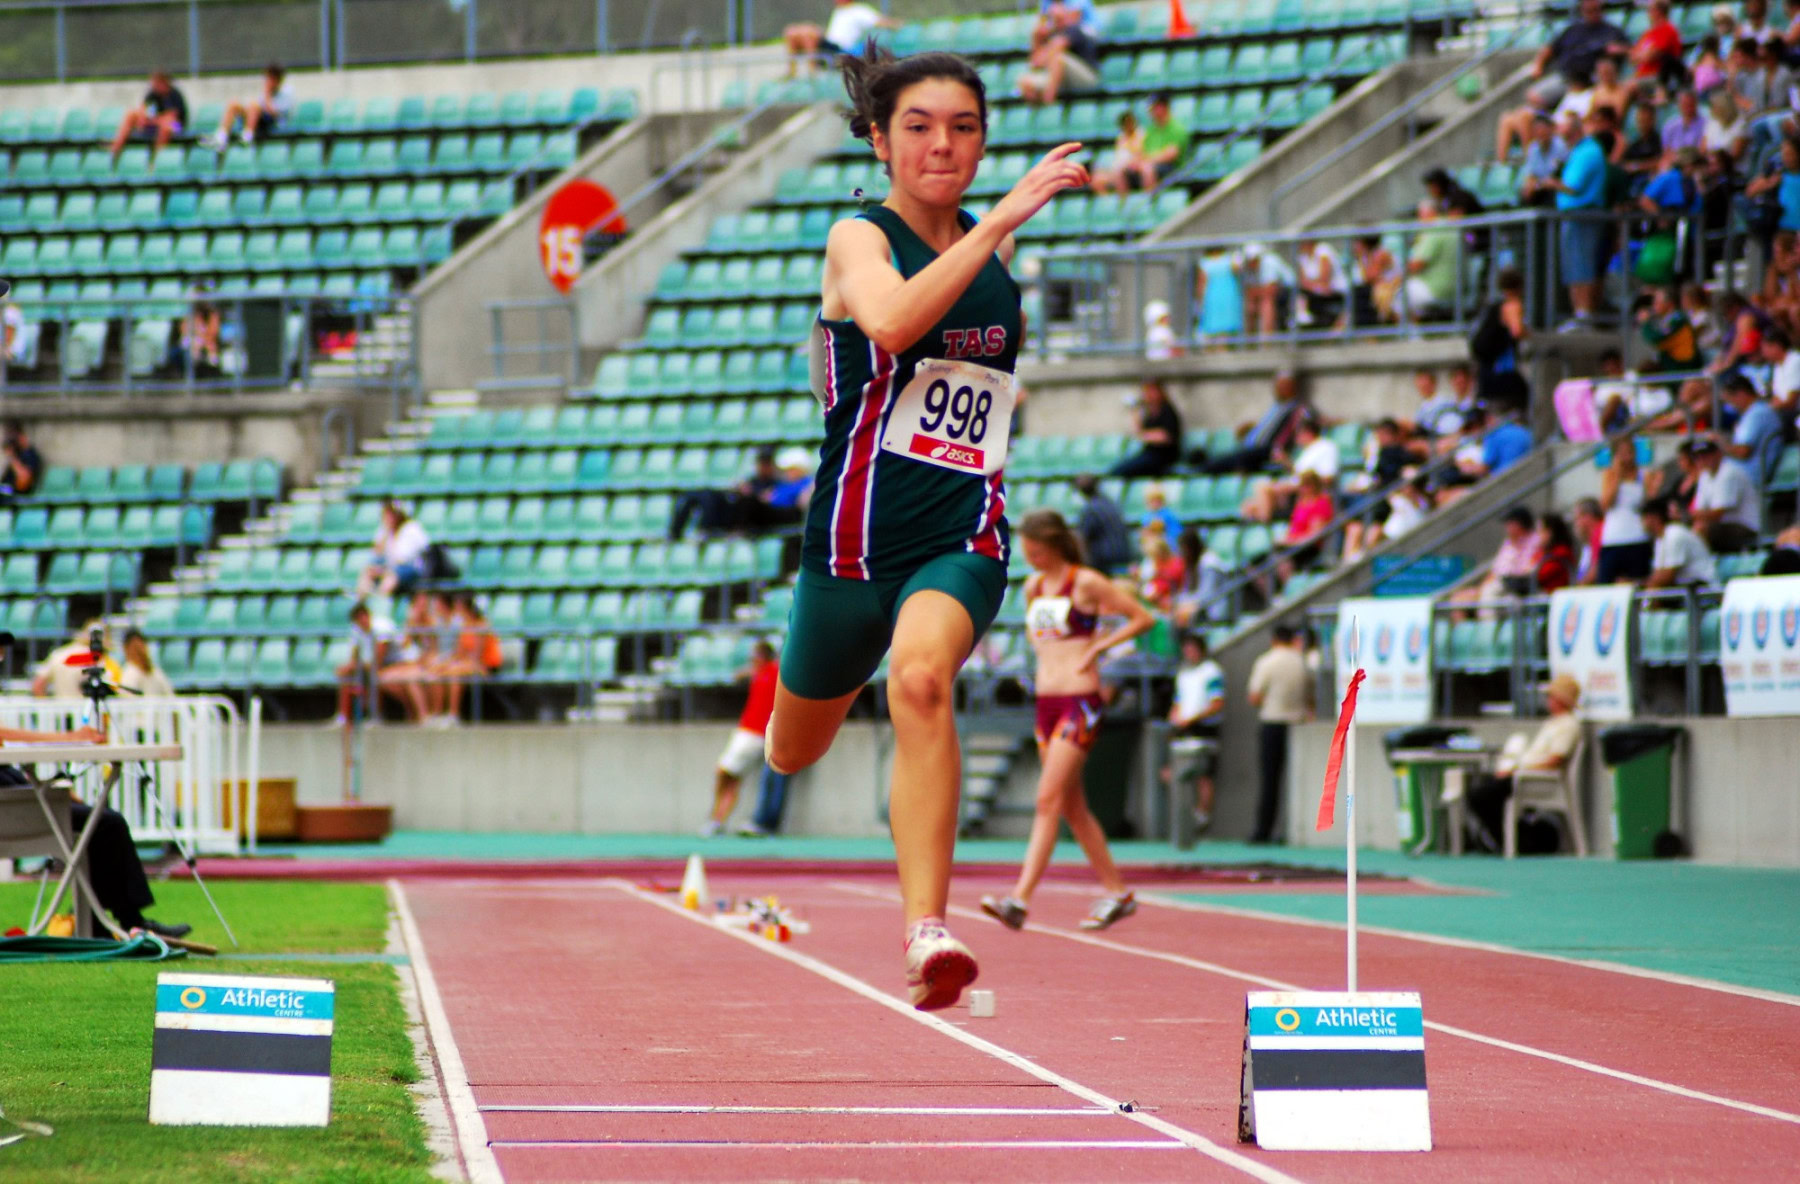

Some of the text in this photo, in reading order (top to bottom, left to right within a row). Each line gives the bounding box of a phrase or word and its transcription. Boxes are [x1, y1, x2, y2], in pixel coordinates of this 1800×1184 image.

[545, 226, 582, 275] 15
[943, 325, 1006, 359] TAS
[919, 378, 993, 445] 998
[220, 988, 305, 1009] Athletic
[274, 1009, 304, 1018] CENTRE
[1315, 1008, 1398, 1027] Athletic
[1369, 1027, 1398, 1036] CENTRE
